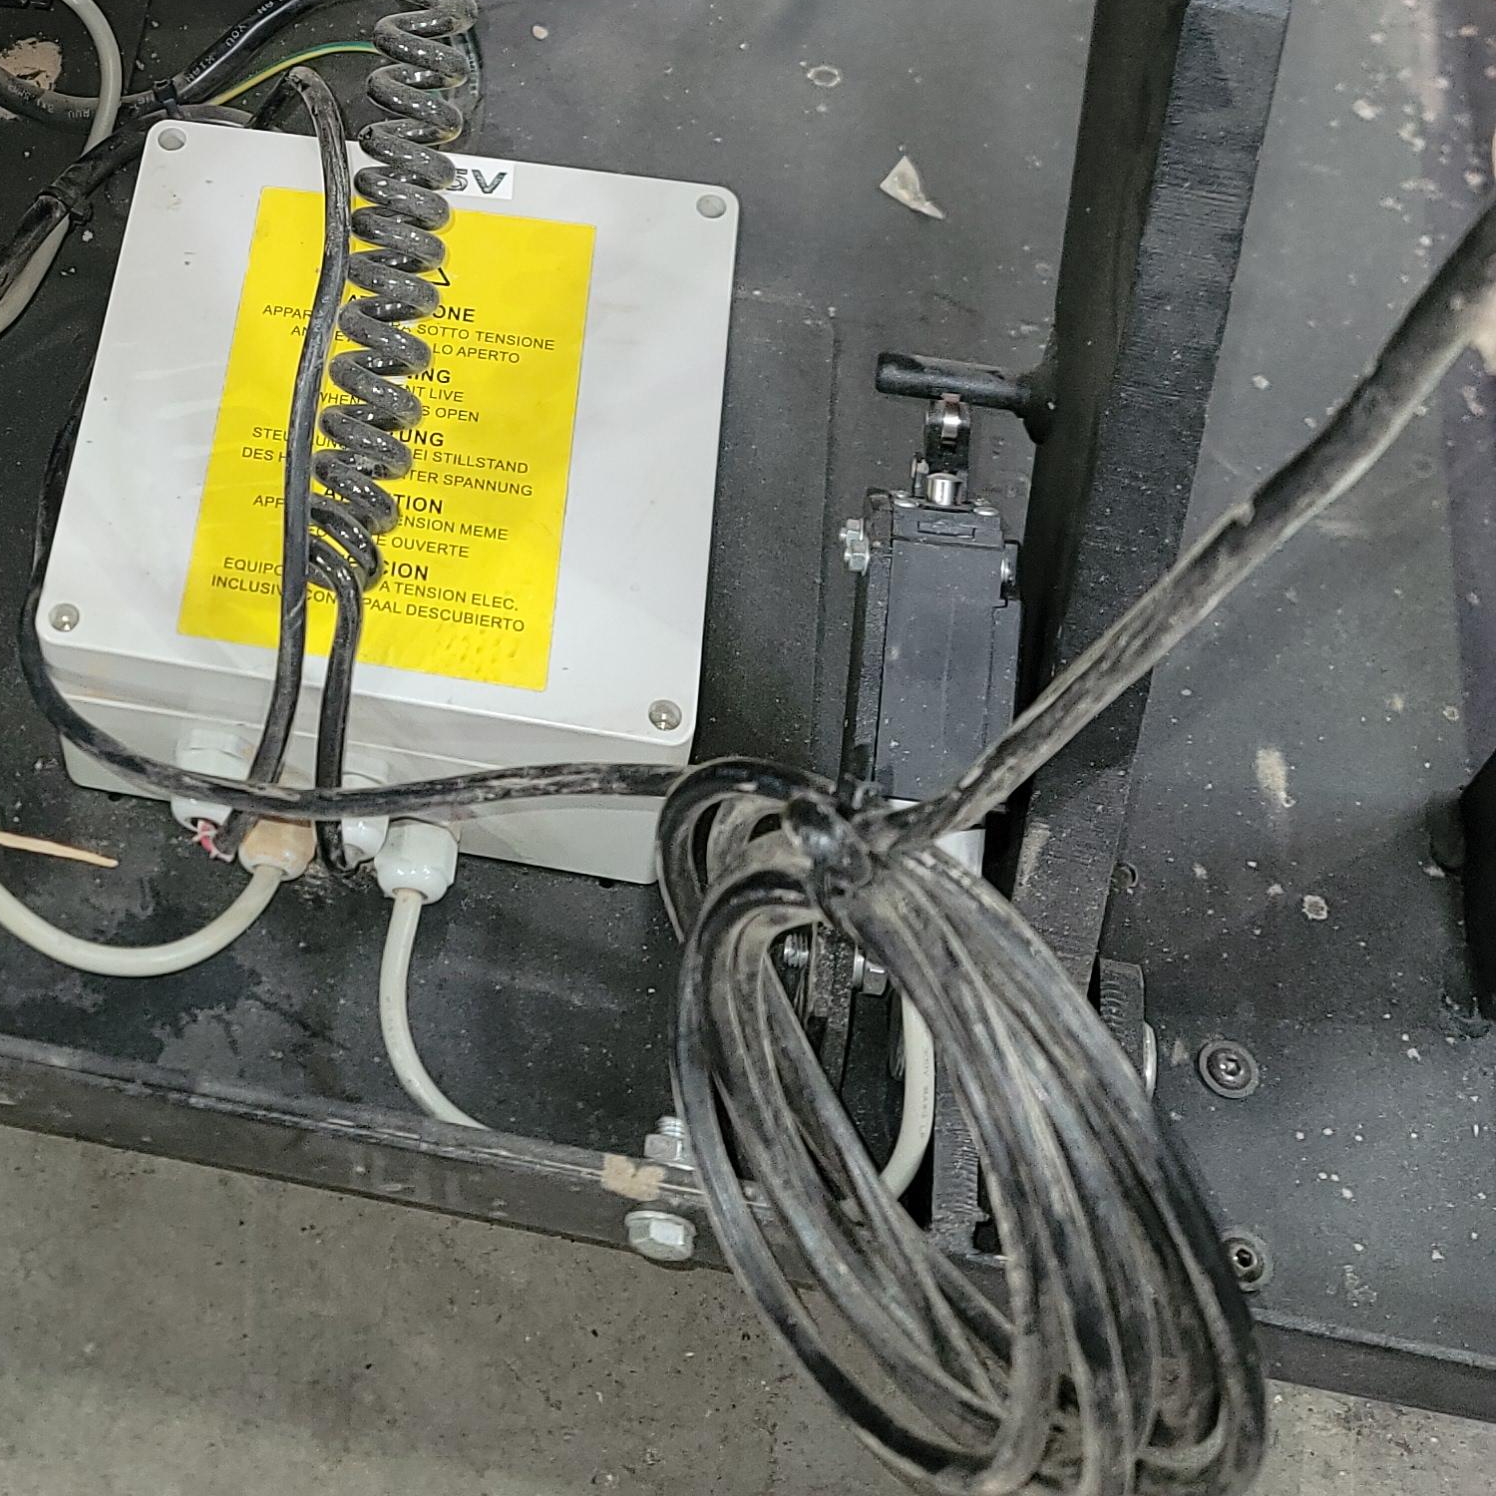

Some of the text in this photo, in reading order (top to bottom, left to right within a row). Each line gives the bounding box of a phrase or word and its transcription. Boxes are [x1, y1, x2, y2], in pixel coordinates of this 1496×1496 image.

[225, 22, 250, 48] YOU
[417, 322, 470, 342] SOTTO
[475, 330, 556, 352] TENSIONE
[455, 346, 521, 364] APERTO
[429, 387, 465, 404] LIVE
[435, 407, 480, 423] OPEN
[241, 446, 276, 462] DES
[442, 472, 534, 497] SPANNUNG
[432, 451, 529, 475] STILLSTAND
[397, 514, 509, 541] ENSION MEME
[391, 536, 470, 559] OUVERTE
[393, 581, 467, 605] TENSION
[470, 593, 520, 612] ELEC.
[405, 603, 525, 633] DESCUBIERTO
